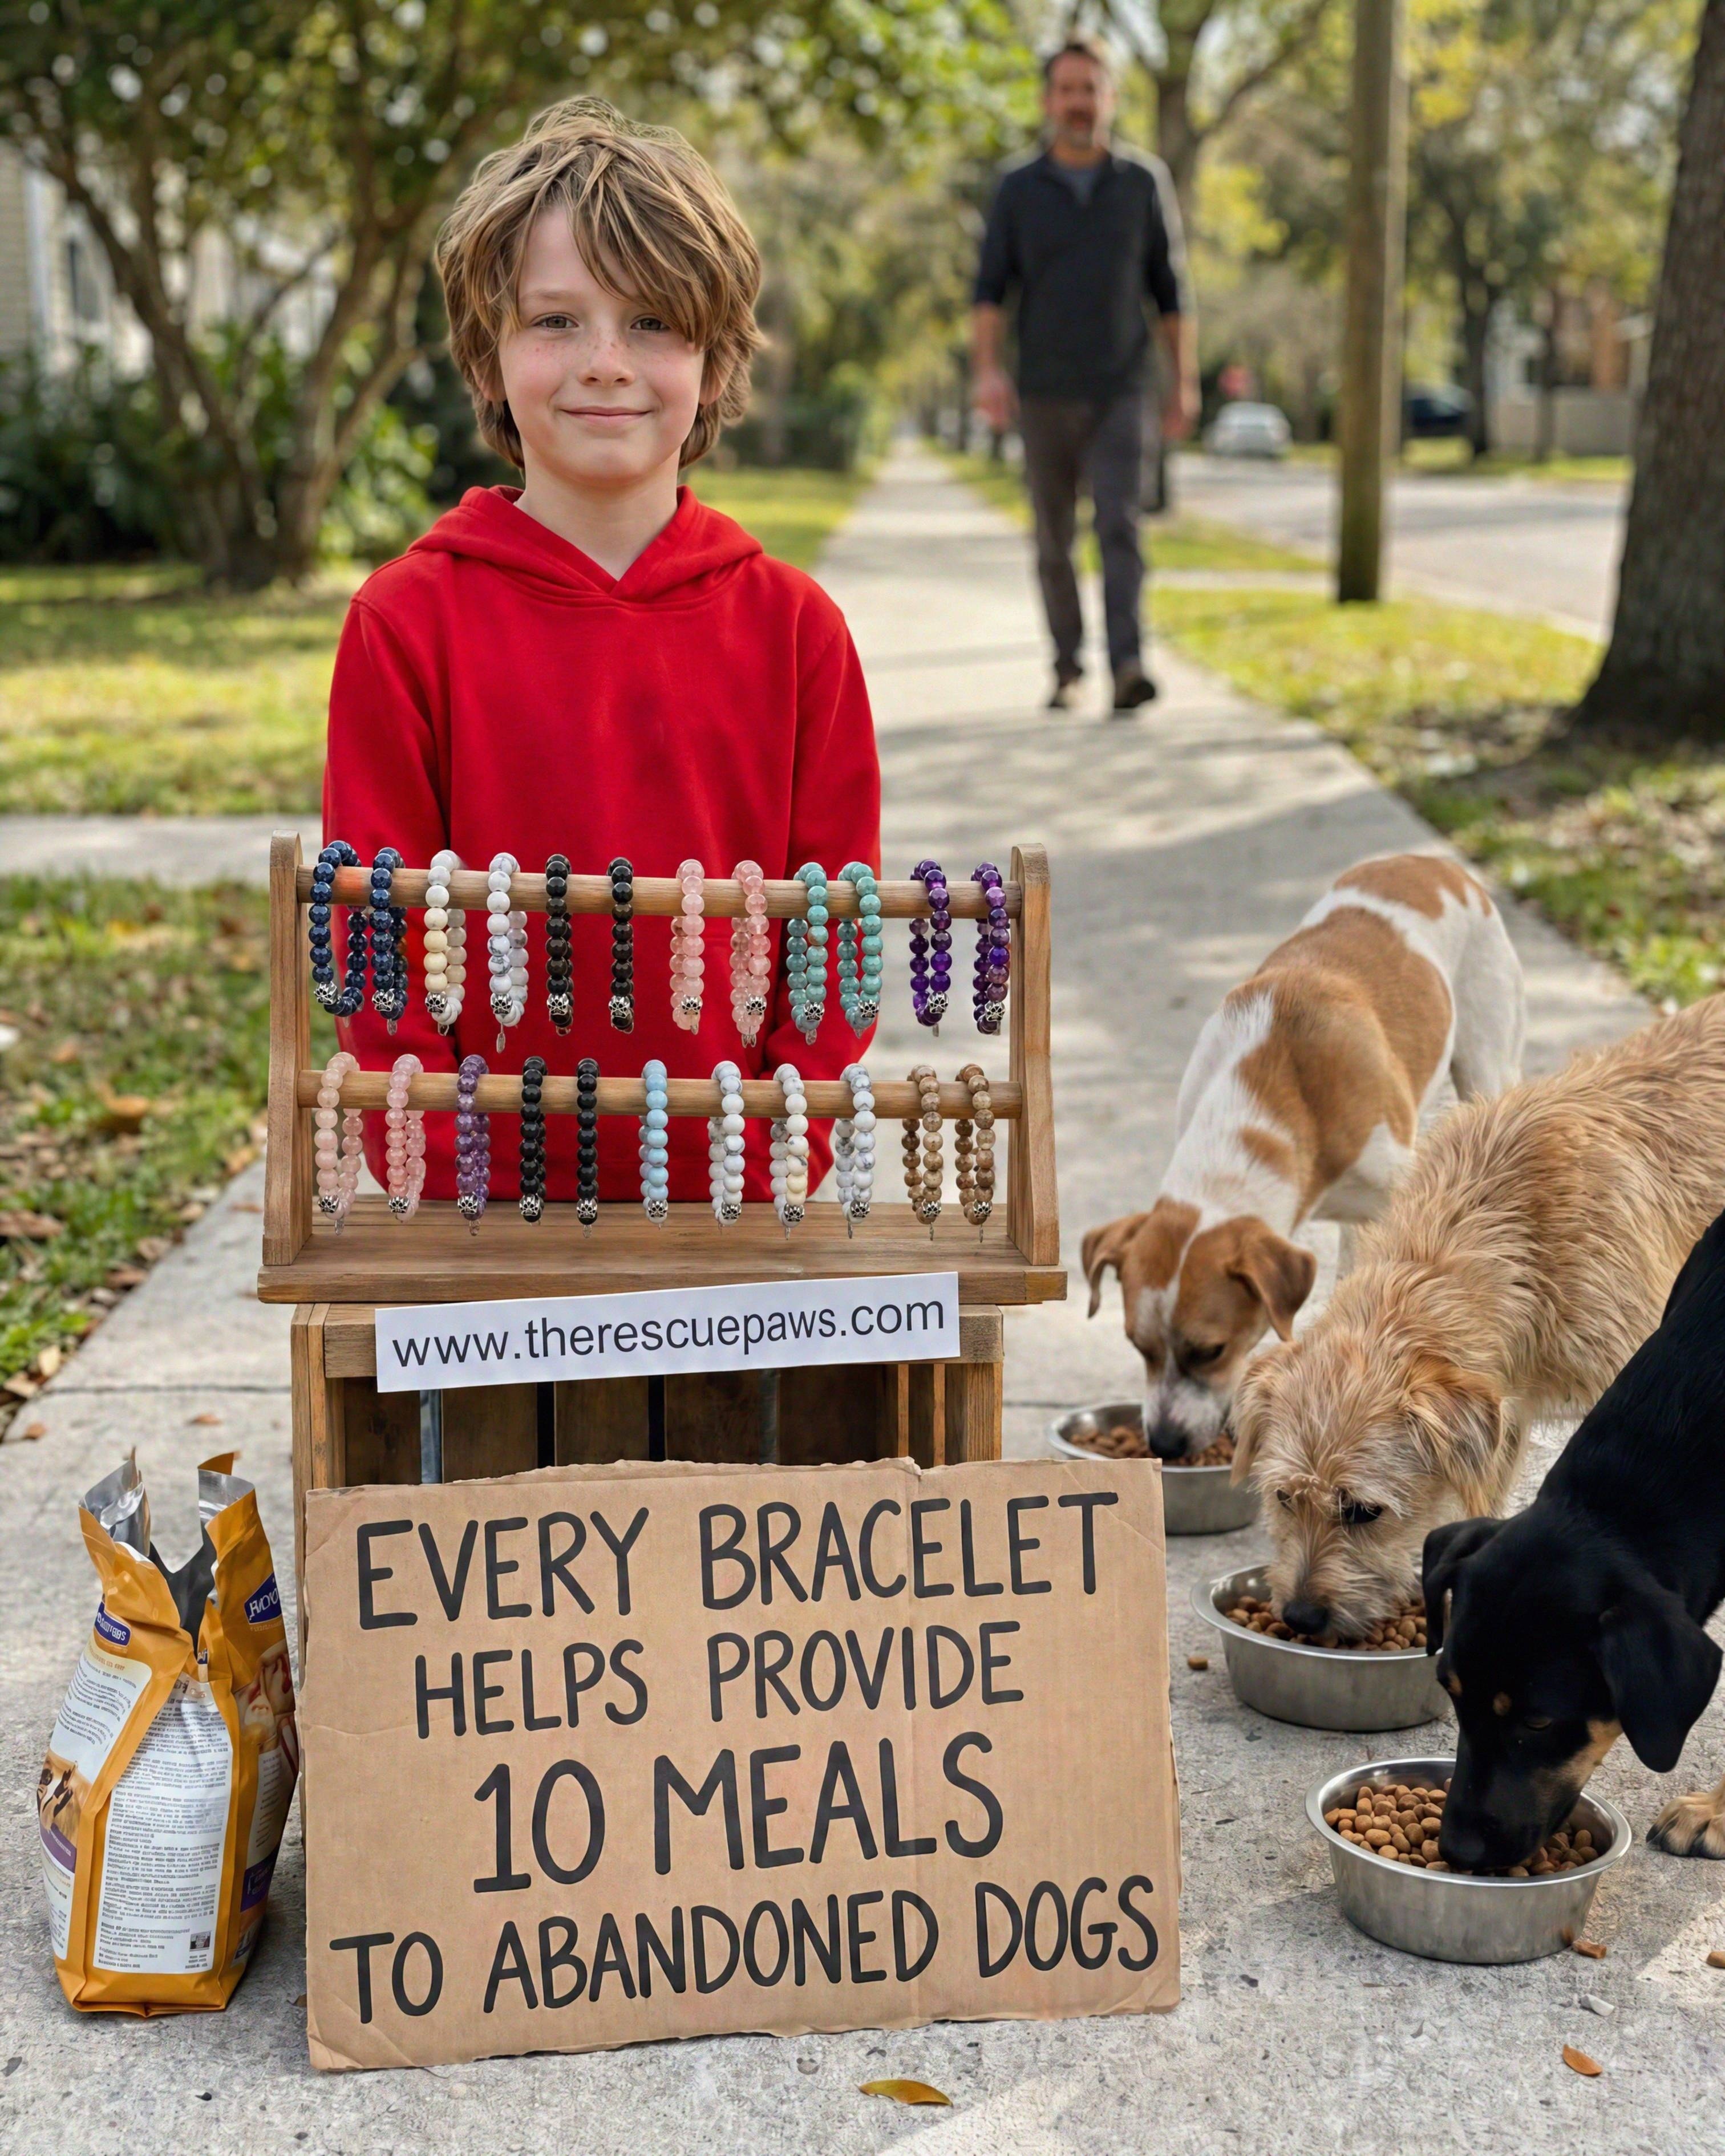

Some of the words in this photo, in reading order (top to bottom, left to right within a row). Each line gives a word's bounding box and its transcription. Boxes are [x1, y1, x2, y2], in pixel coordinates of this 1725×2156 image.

[391, 1299, 945, 1368] www.therescuepaws.com
[356, 1506, 650, 1631] EVERY
[698, 1491, 1119, 1611] BRACELET
[415, 1639, 649, 1740] HELPS
[707, 1620, 1025, 1723] PROVIDE
[473, 1758, 606, 1894] 10
[653, 1731, 1003, 1876] MEALS
[329, 1931, 444, 2025] TO
[483, 1890, 940, 2014] ABANDONED
[974, 1874, 1159, 1979] DOGS
